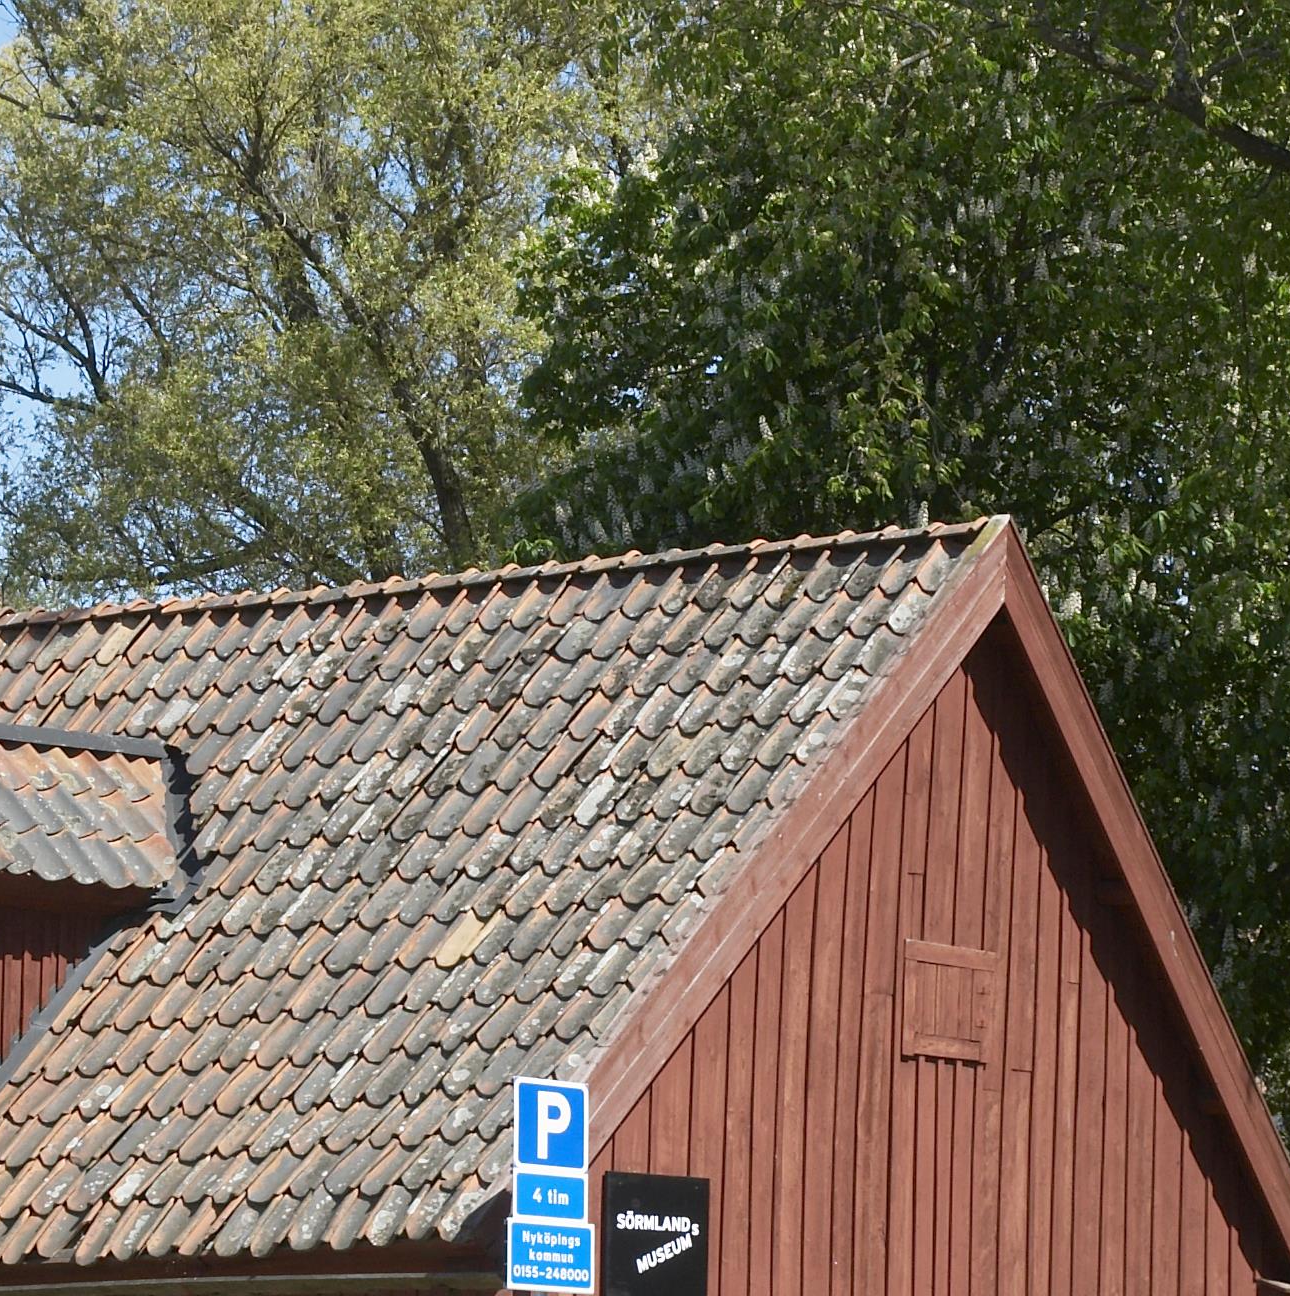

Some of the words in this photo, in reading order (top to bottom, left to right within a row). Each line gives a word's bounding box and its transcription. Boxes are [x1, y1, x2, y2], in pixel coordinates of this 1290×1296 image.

[536, 1090, 571, 1159] P
[532, 1188, 542, 1203] 4
[547, 1189, 569, 1205] tim
[522, 1230, 581, 1249] Nyköpings
[528, 1248, 574, 1263] kommun
[635, 1233, 692, 1274] MUSEUM
[513, 1264, 589, 1282] 0155-248000
